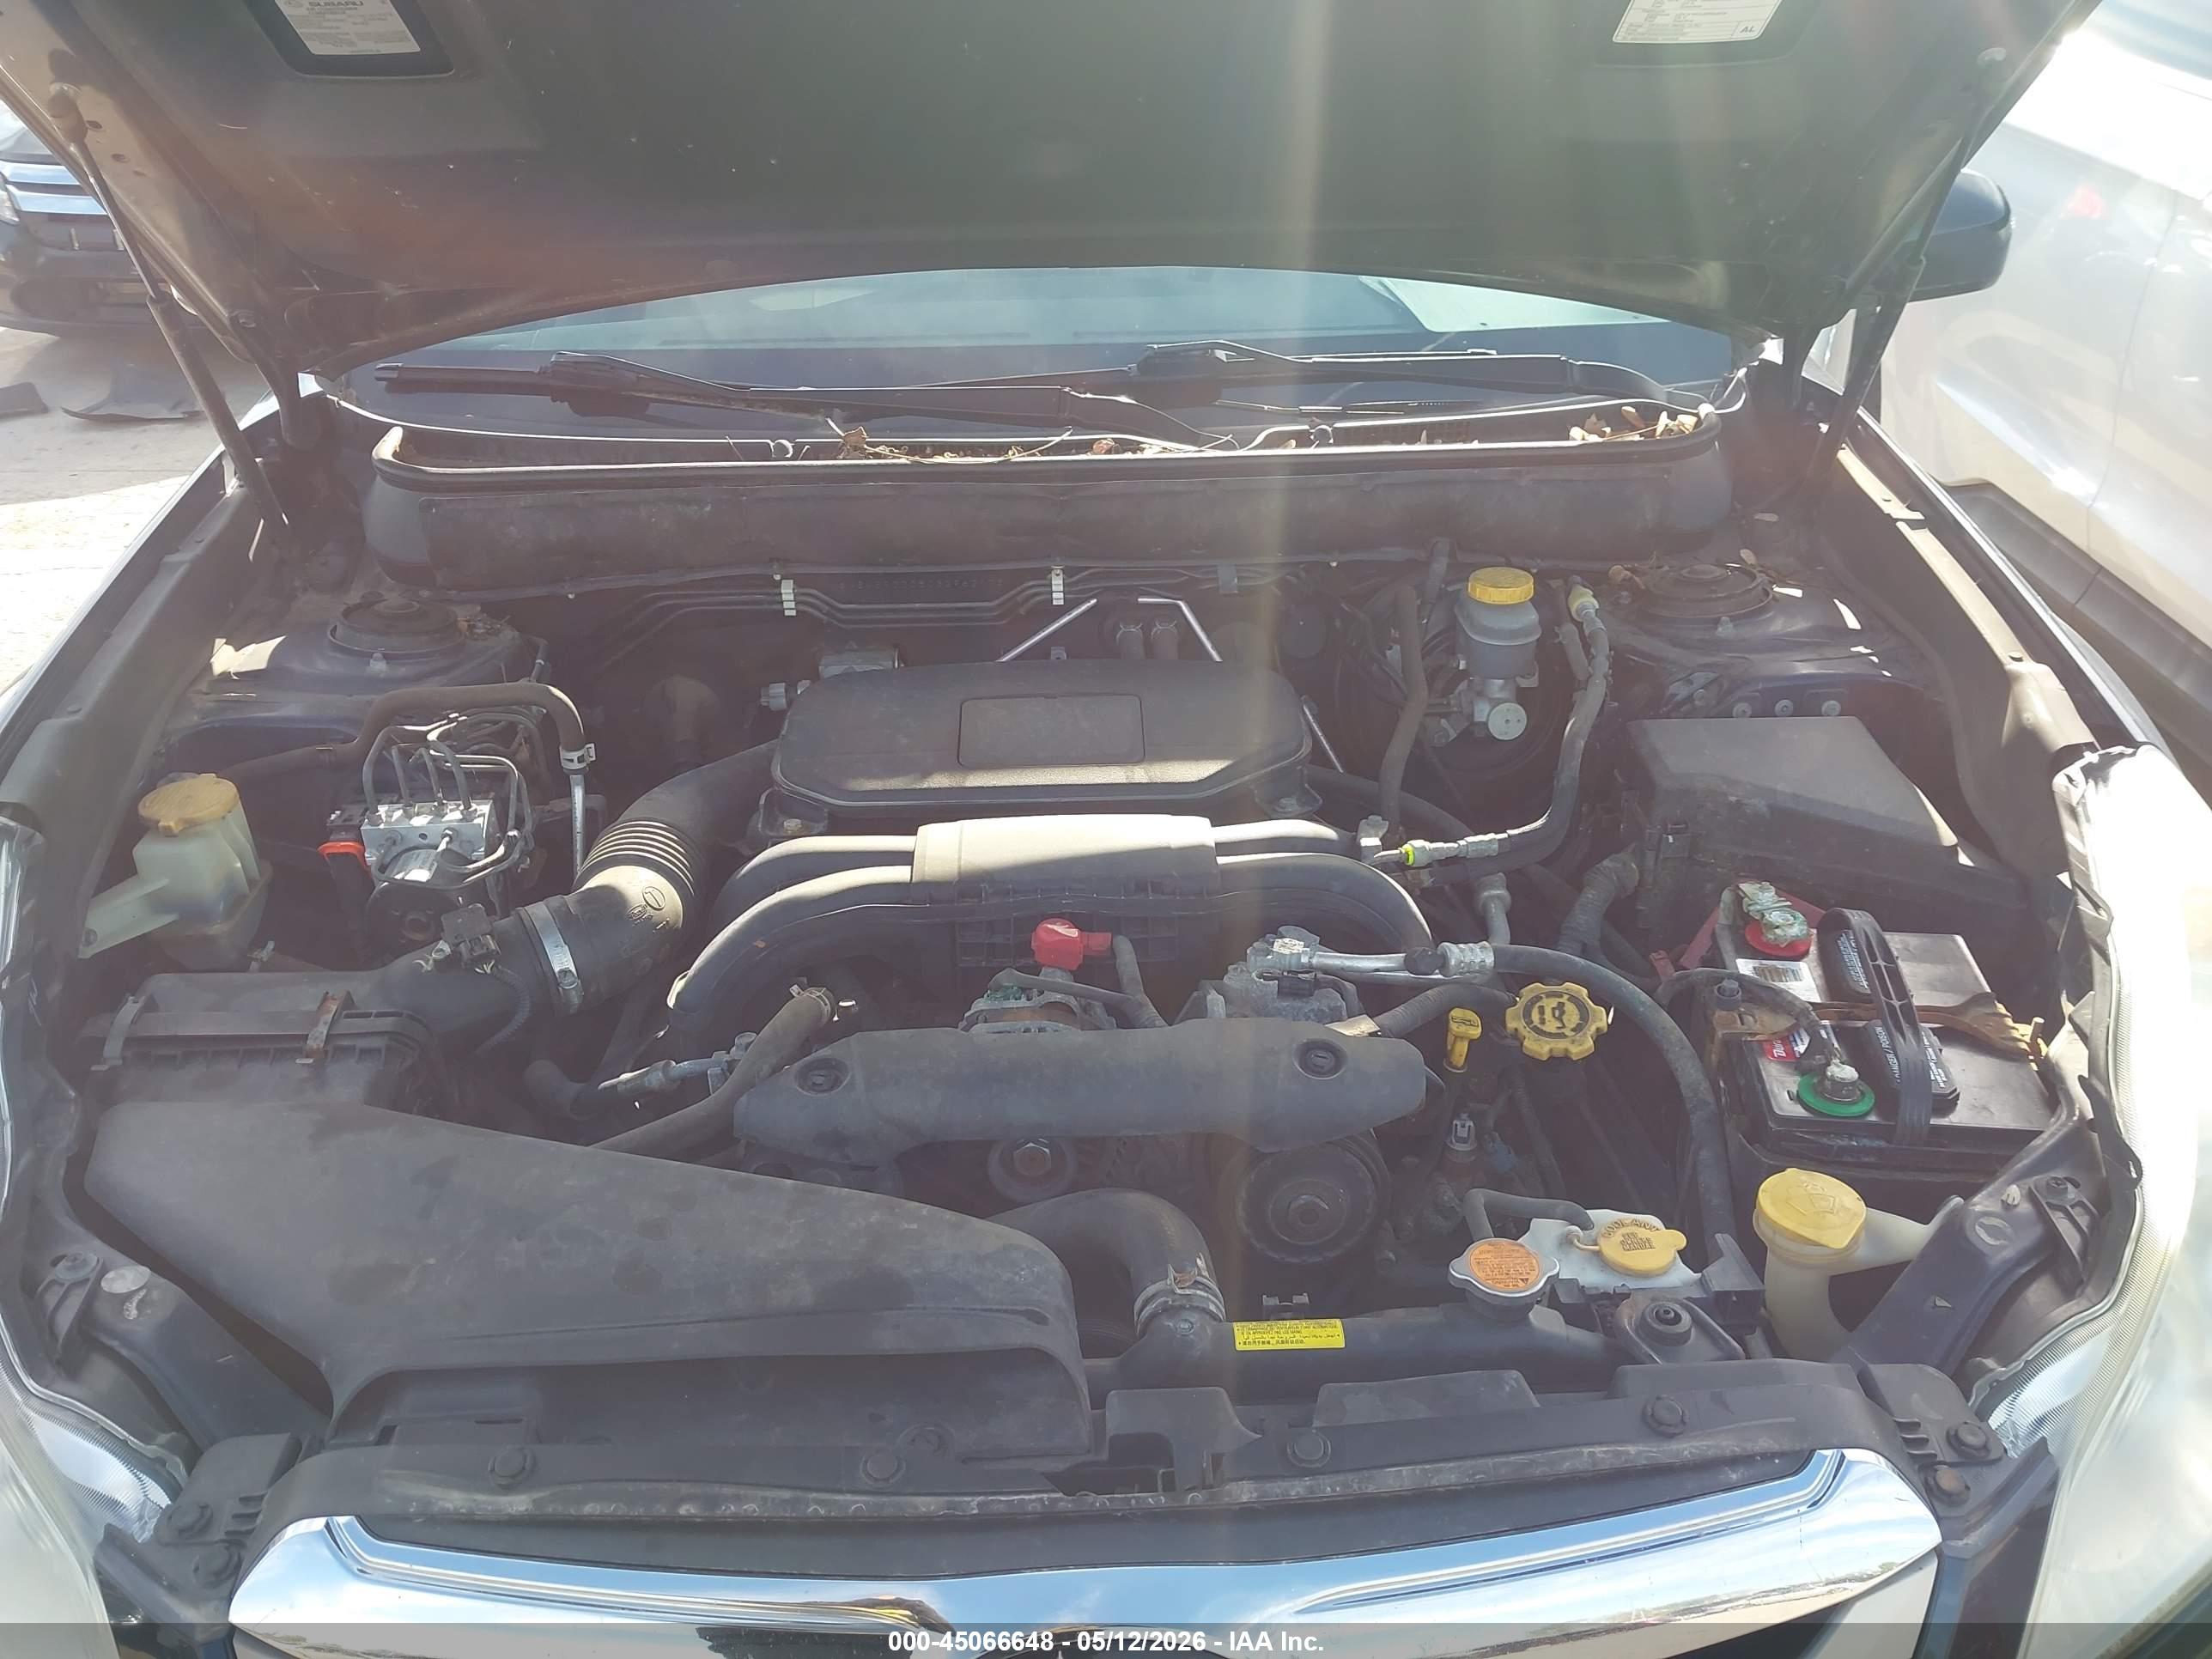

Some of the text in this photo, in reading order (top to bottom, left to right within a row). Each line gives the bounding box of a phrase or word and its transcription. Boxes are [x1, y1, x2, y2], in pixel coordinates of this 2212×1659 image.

[1875, 1026, 1891, 1048] POISON
[1772, 1037, 1787, 1058] Dura
[1601, 1217, 1661, 1237] COOLANT
[1622, 1242, 1656, 1252] MANUAL
